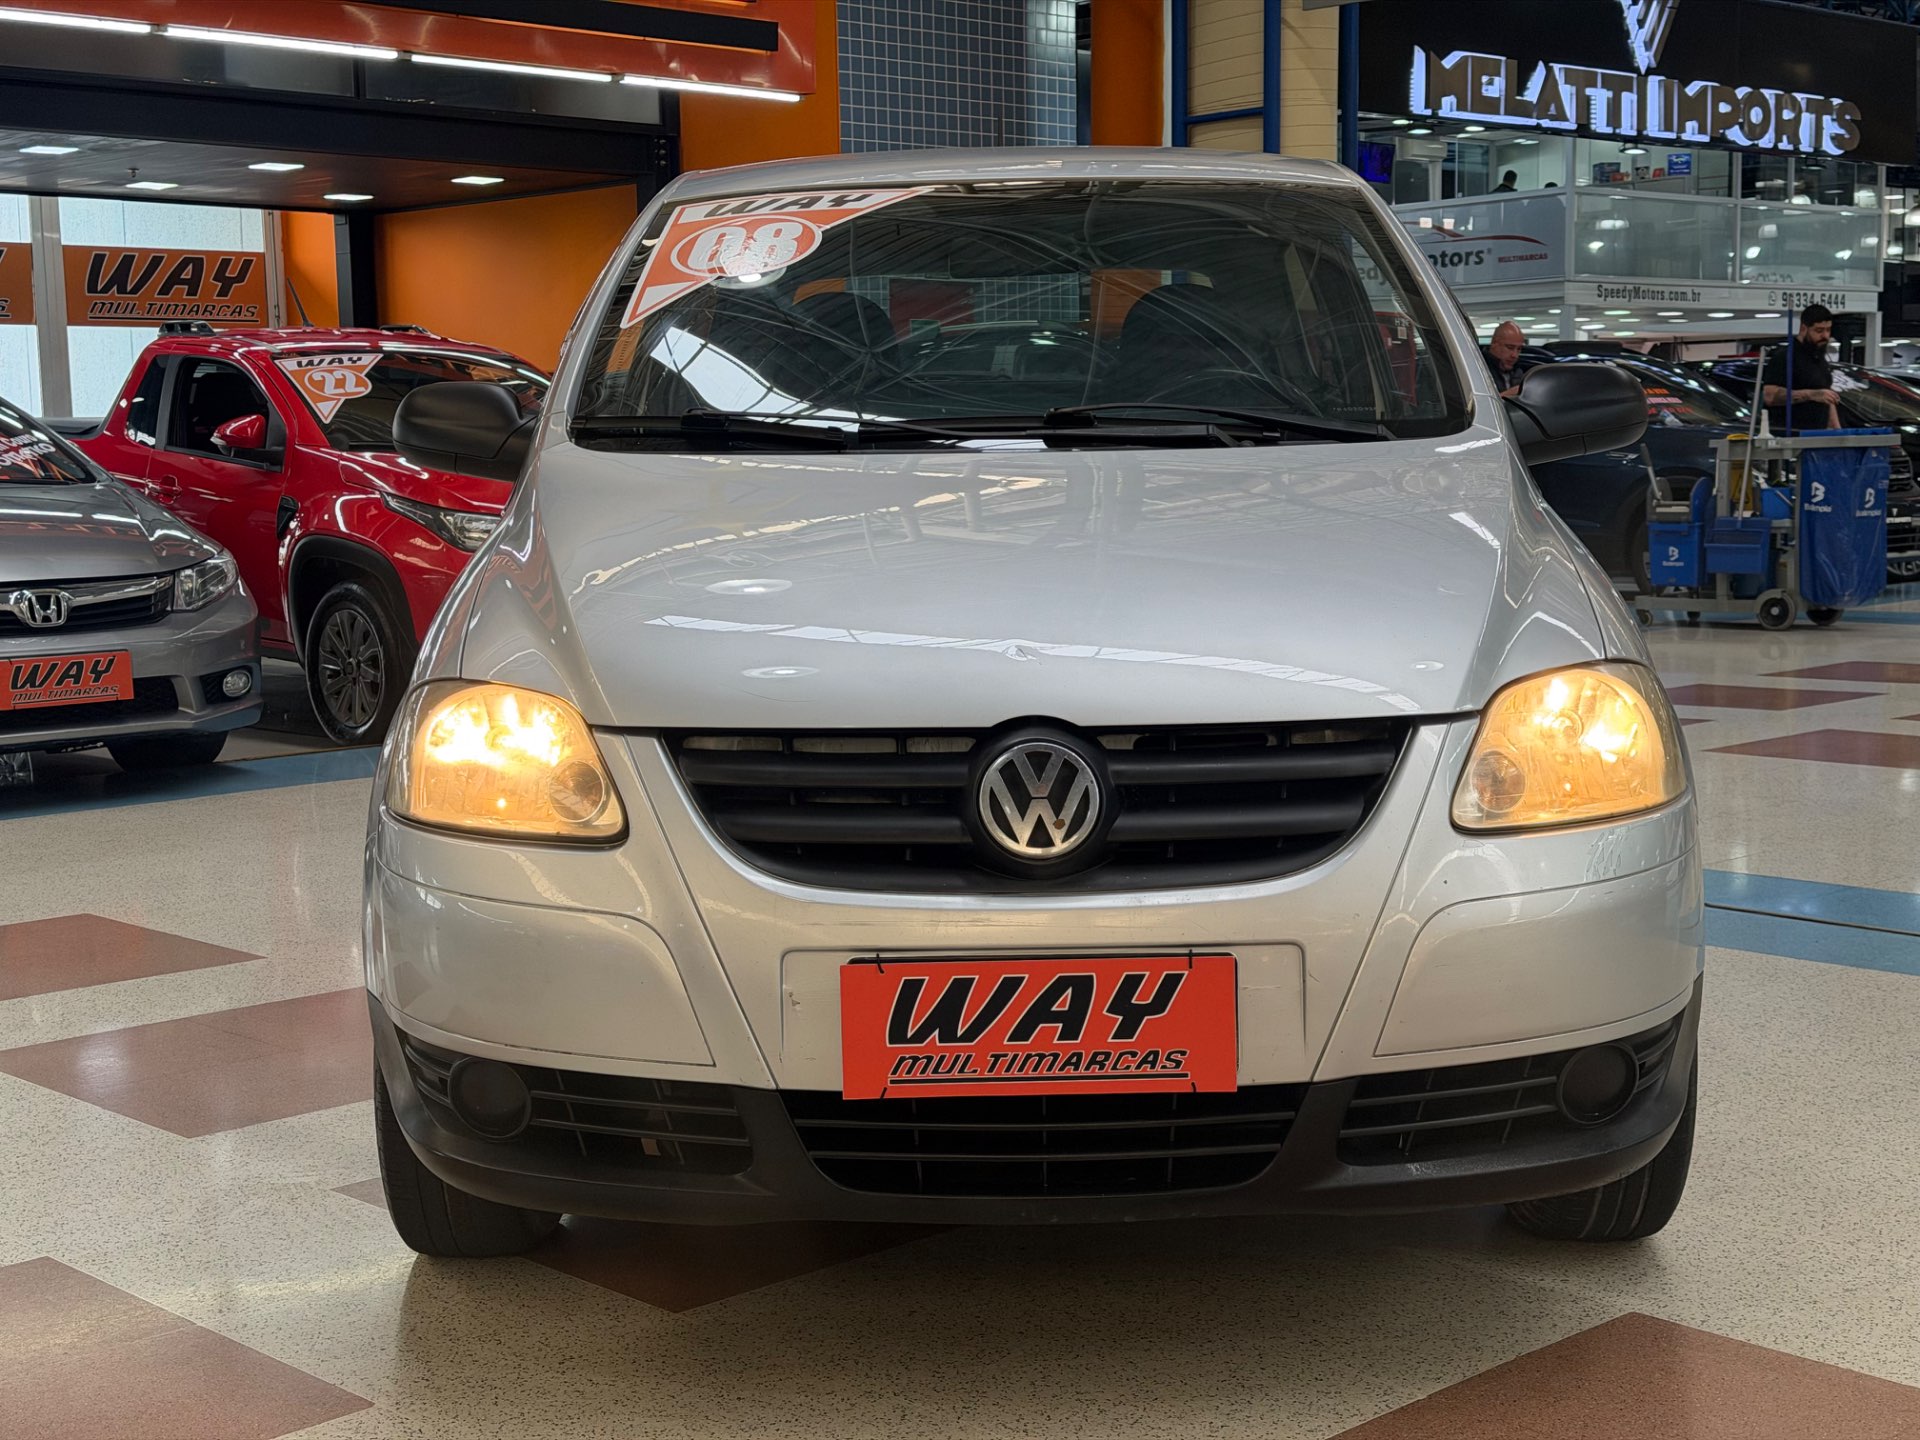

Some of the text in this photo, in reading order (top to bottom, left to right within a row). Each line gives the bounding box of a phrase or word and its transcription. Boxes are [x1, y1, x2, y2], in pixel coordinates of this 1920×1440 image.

[1648, 74, 1862, 156] IMPORTS
[703, 194, 875, 218] WAY
[687, 222, 803, 273] 08
[85, 251, 256, 299] WAY
[1597, 284, 1701, 303] SpeedyMotors.com.br
[90, 300, 258, 319] MULTIMARCAS
[296, 357, 362, 369] WAY
[311, 370, 366, 395] 22
[9, 655, 117, 690] WAY
[12, 685, 119, 702] MULTIMARCAS
[887, 971, 1188, 1047] WAY
[889, 1049, 1187, 1078] MULTIMARCAS
